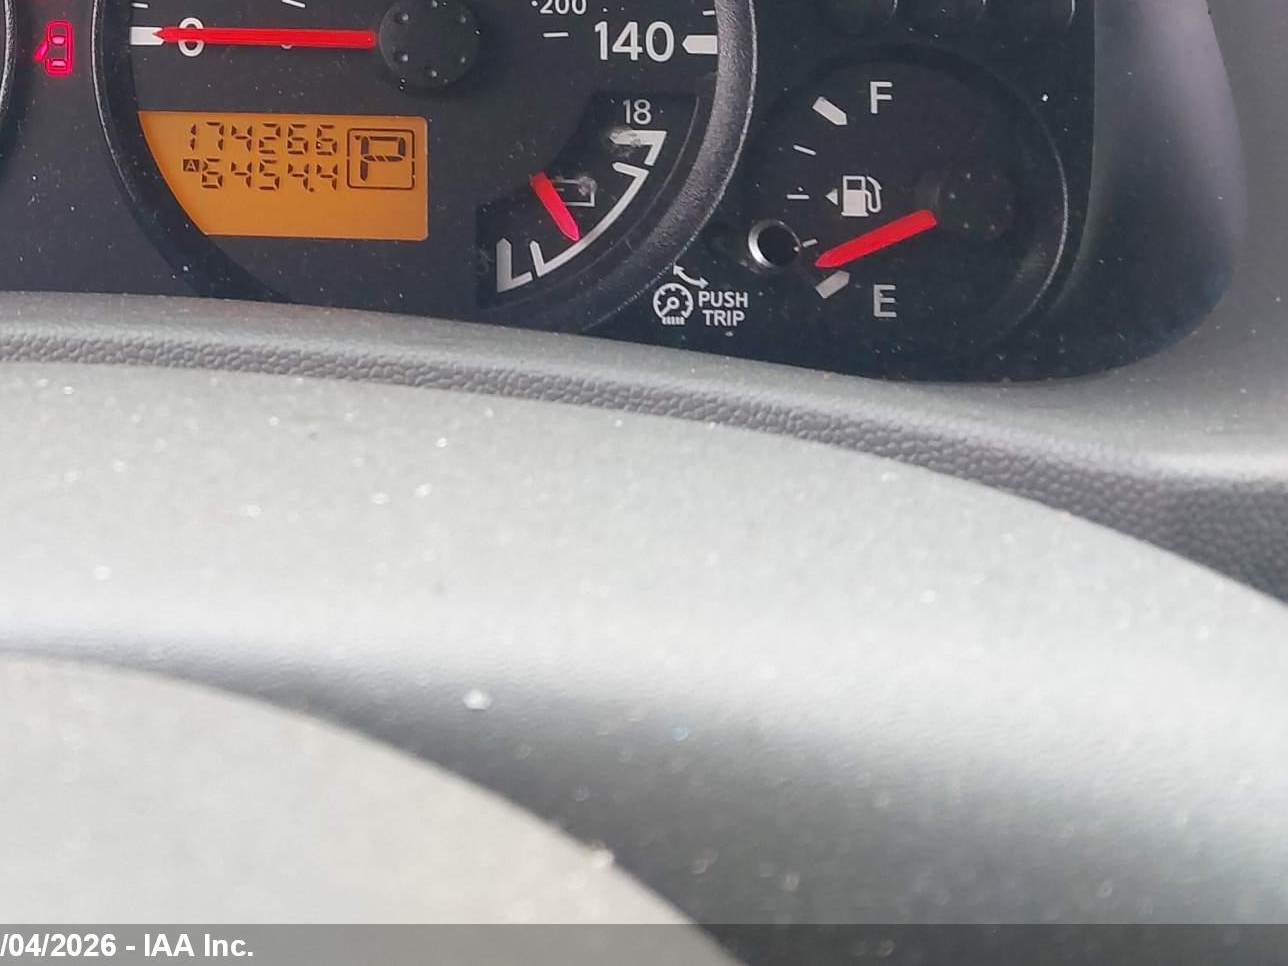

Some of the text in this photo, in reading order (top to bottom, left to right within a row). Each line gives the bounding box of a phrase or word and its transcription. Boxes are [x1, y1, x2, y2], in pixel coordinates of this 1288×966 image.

[595, 22, 674, 61] 140
[624, 100, 651, 124] 18
[870, 82, 892, 113] F
[190, 122, 337, 156] 174266
[355, 135, 406, 181] P
[202, 158, 338, 192] 6454.4
[699, 291, 748, 307] PUSH
[874, 285, 896, 317] E
[702, 310, 744, 326] TRIP
